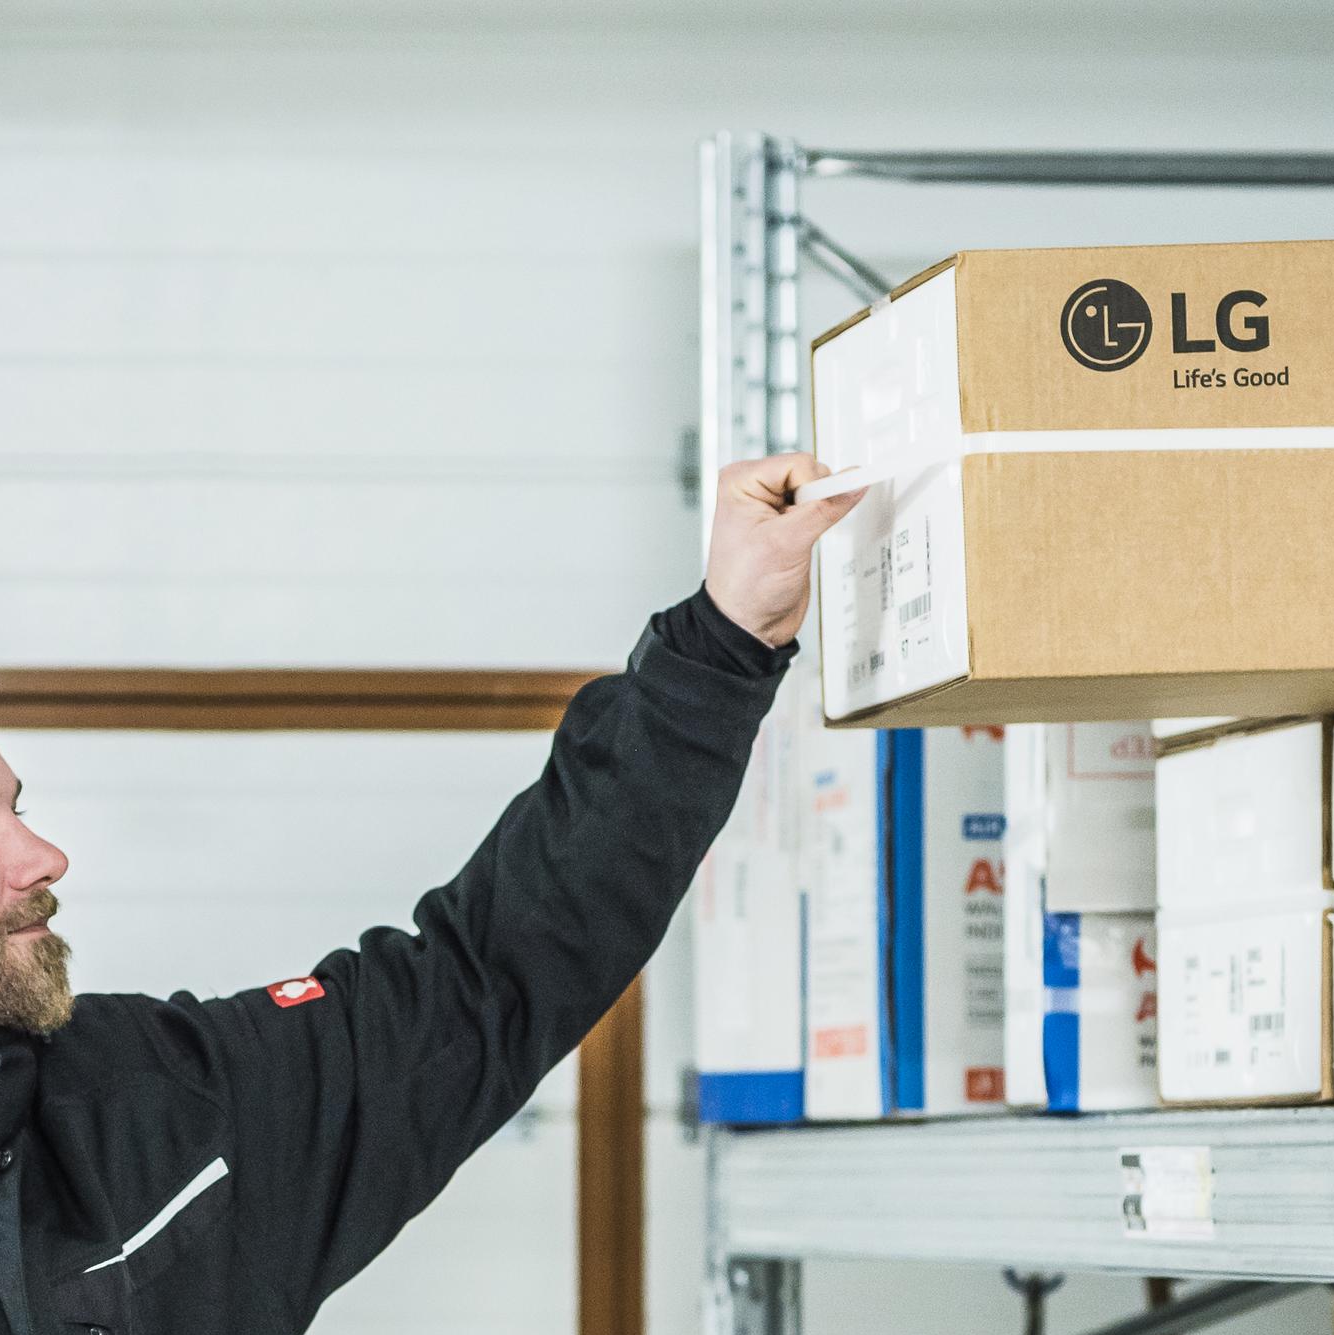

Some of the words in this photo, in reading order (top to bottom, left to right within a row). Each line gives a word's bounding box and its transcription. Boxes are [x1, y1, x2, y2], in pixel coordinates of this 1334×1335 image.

[1171, 289, 1270, 353] LG
[1173, 368, 1226, 389] Life's
[1233, 366, 1289, 387] Good
